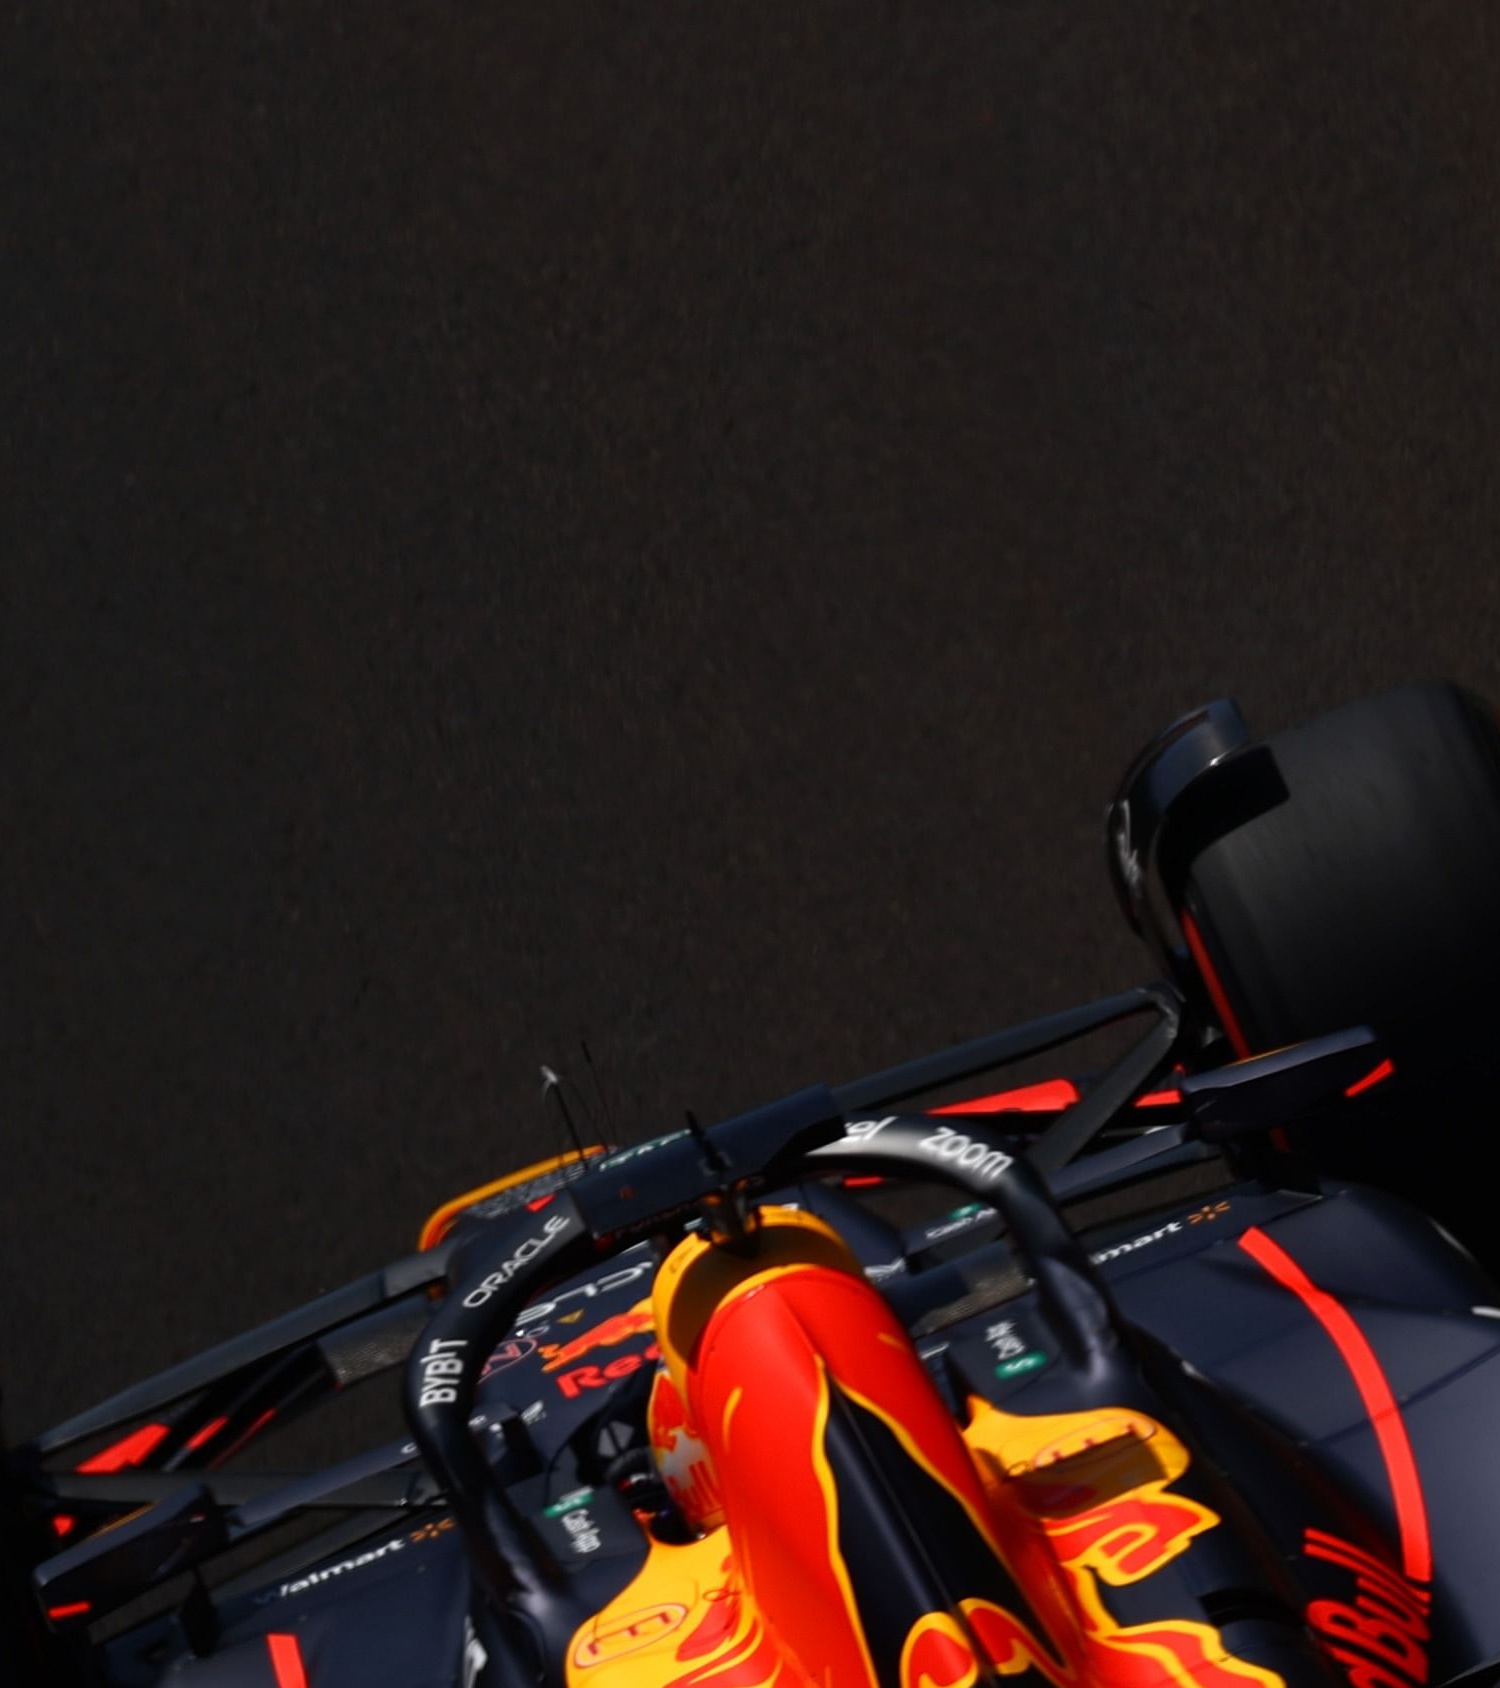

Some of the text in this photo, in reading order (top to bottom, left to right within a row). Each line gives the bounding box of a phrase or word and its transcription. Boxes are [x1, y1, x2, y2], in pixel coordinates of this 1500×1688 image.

[920, 1126, 1014, 1178] zoom
[462, 1215, 570, 1308] ORACLE
[419, 1338, 468, 1408] BYBIT
[555, 1341, 662, 1400] Re
